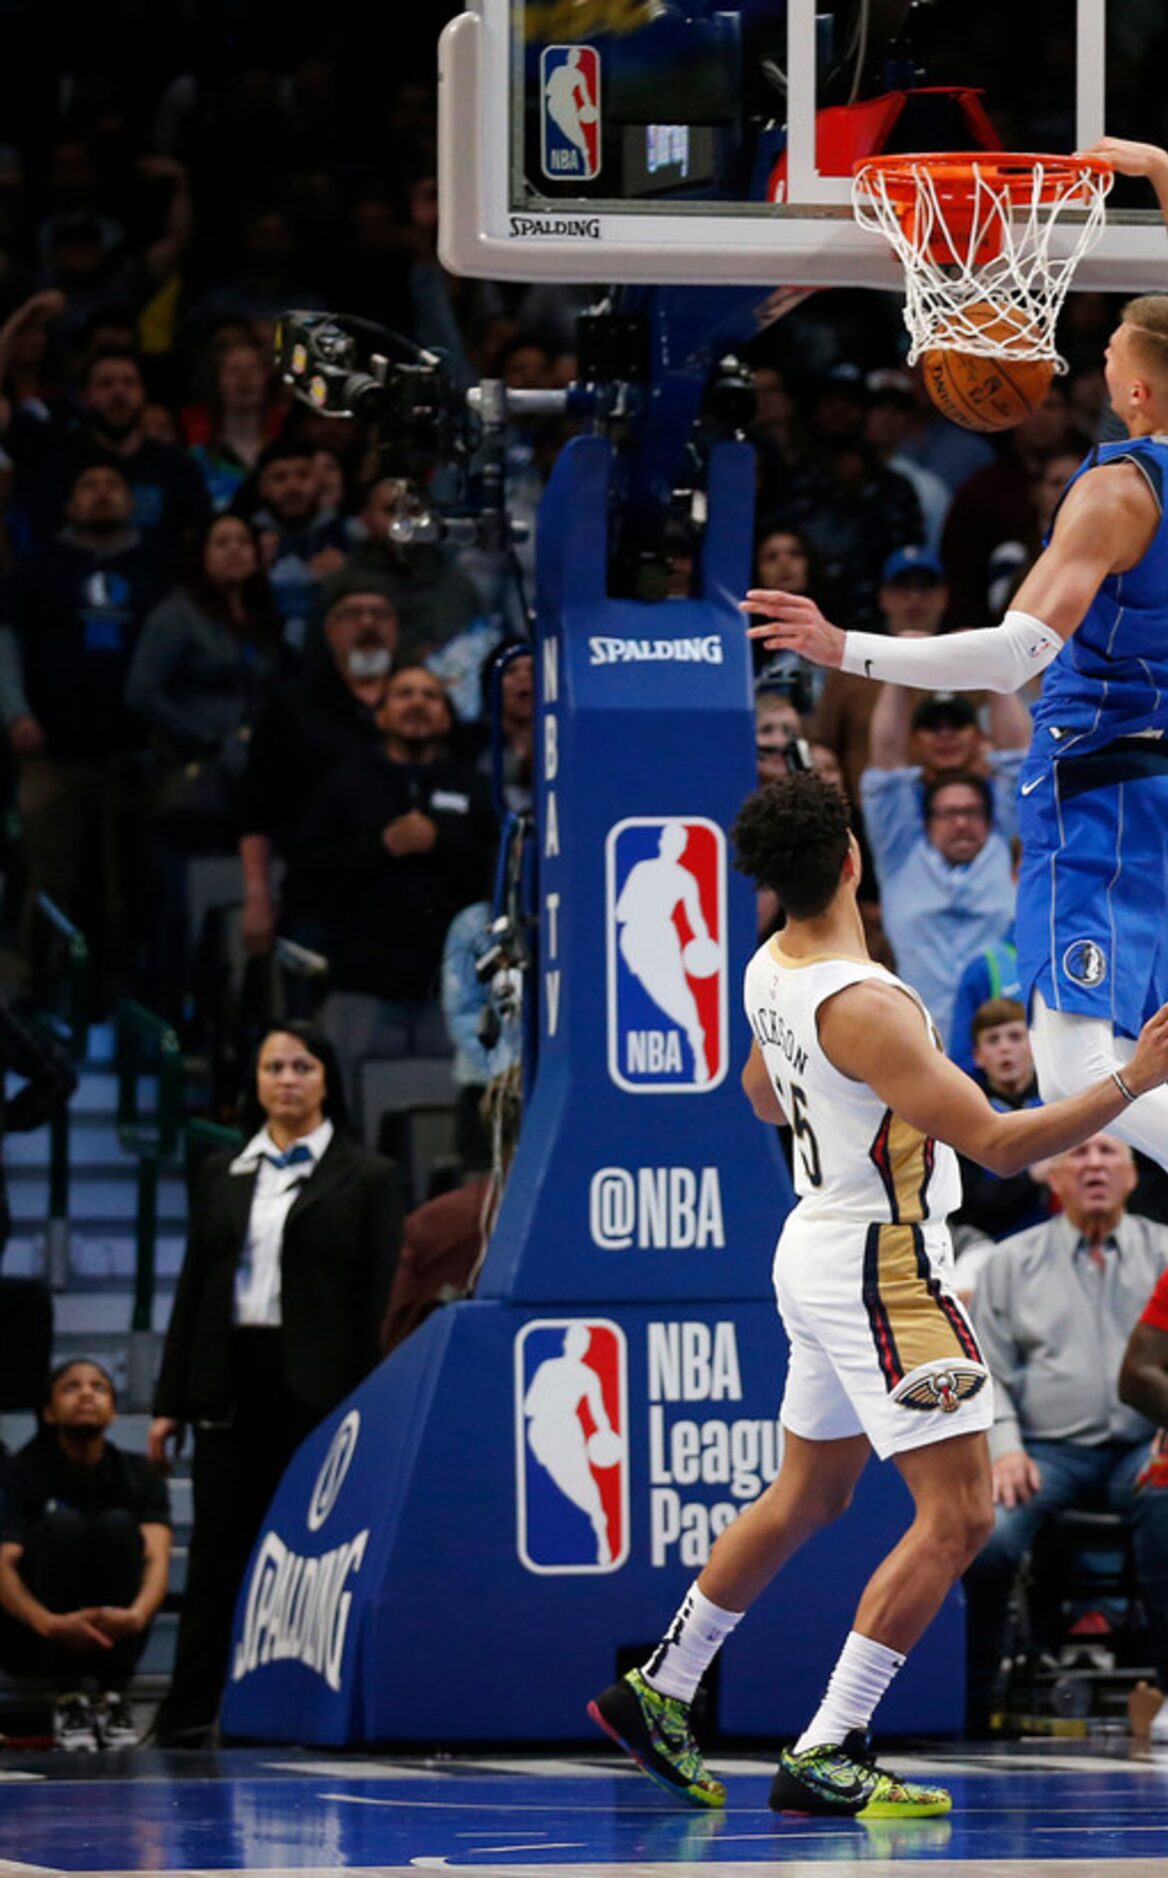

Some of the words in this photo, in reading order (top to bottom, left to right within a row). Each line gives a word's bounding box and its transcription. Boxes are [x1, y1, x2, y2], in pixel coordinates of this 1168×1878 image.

[551, 149, 578, 170] NBA
[510, 217, 602, 238] SPALDING
[589, 634, 724, 665] SPALDING
[626, 1030, 683, 1074] NBA
[774, 1075, 823, 1189] 5
[589, 1166, 726, 1250] @NBA
[647, 1320, 743, 1401] NBA
[648, 1404, 785, 1499] Leagu
[651, 1487, 752, 1568] Pas
[231, 1528, 370, 1693] SPALDING
